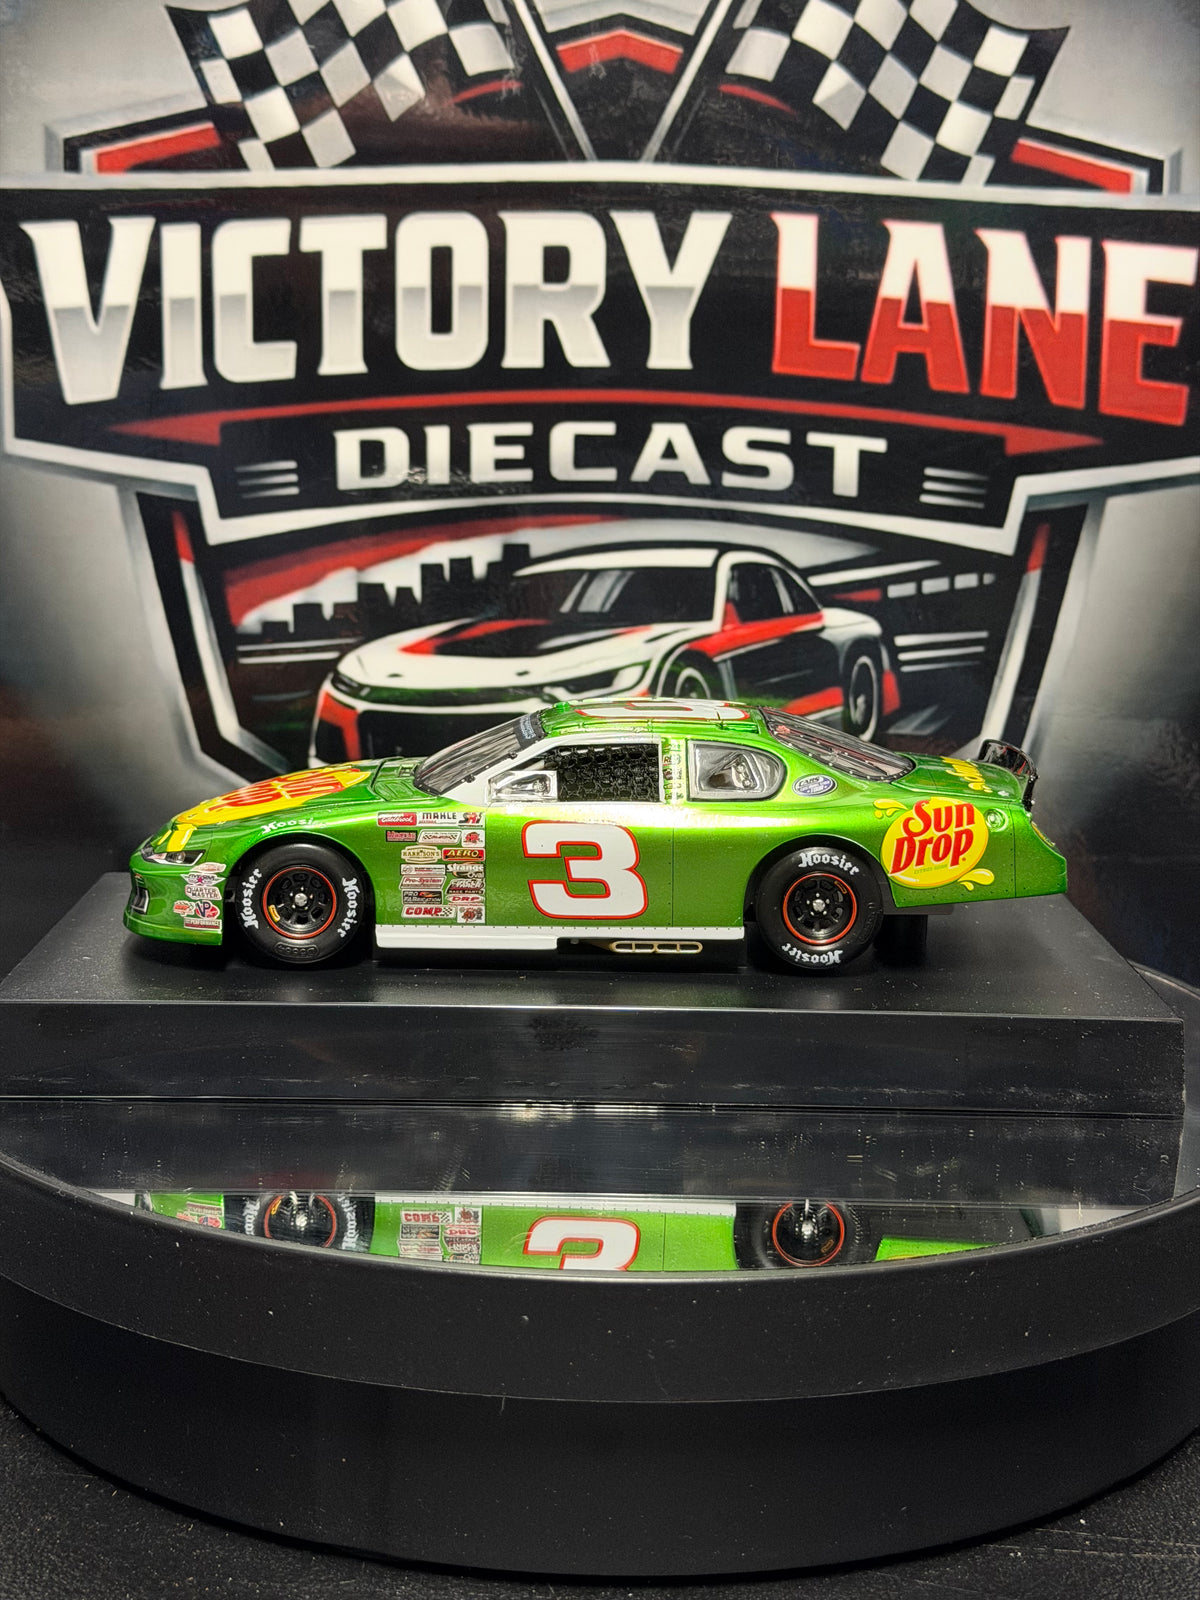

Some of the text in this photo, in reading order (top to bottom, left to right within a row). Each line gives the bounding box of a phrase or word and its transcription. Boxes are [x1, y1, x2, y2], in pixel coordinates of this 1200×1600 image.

[19, 210, 1198, 426] VICTORY LANE
[333, 421, 888, 497] DIECAST
[422, 812, 457, 820] MAHLE
[902, 800, 975, 838] Sun
[447, 849, 479, 857] AERO
[521, 819, 649, 919] 3
[798, 852, 860, 875] Hoosier
[888, 828, 974, 875] Drop
[240, 868, 263, 929] Hoosier
[337, 877, 361, 938] Hoosier
[405, 907, 443, 915] COMP
[781, 943, 843, 966] Hoosier
